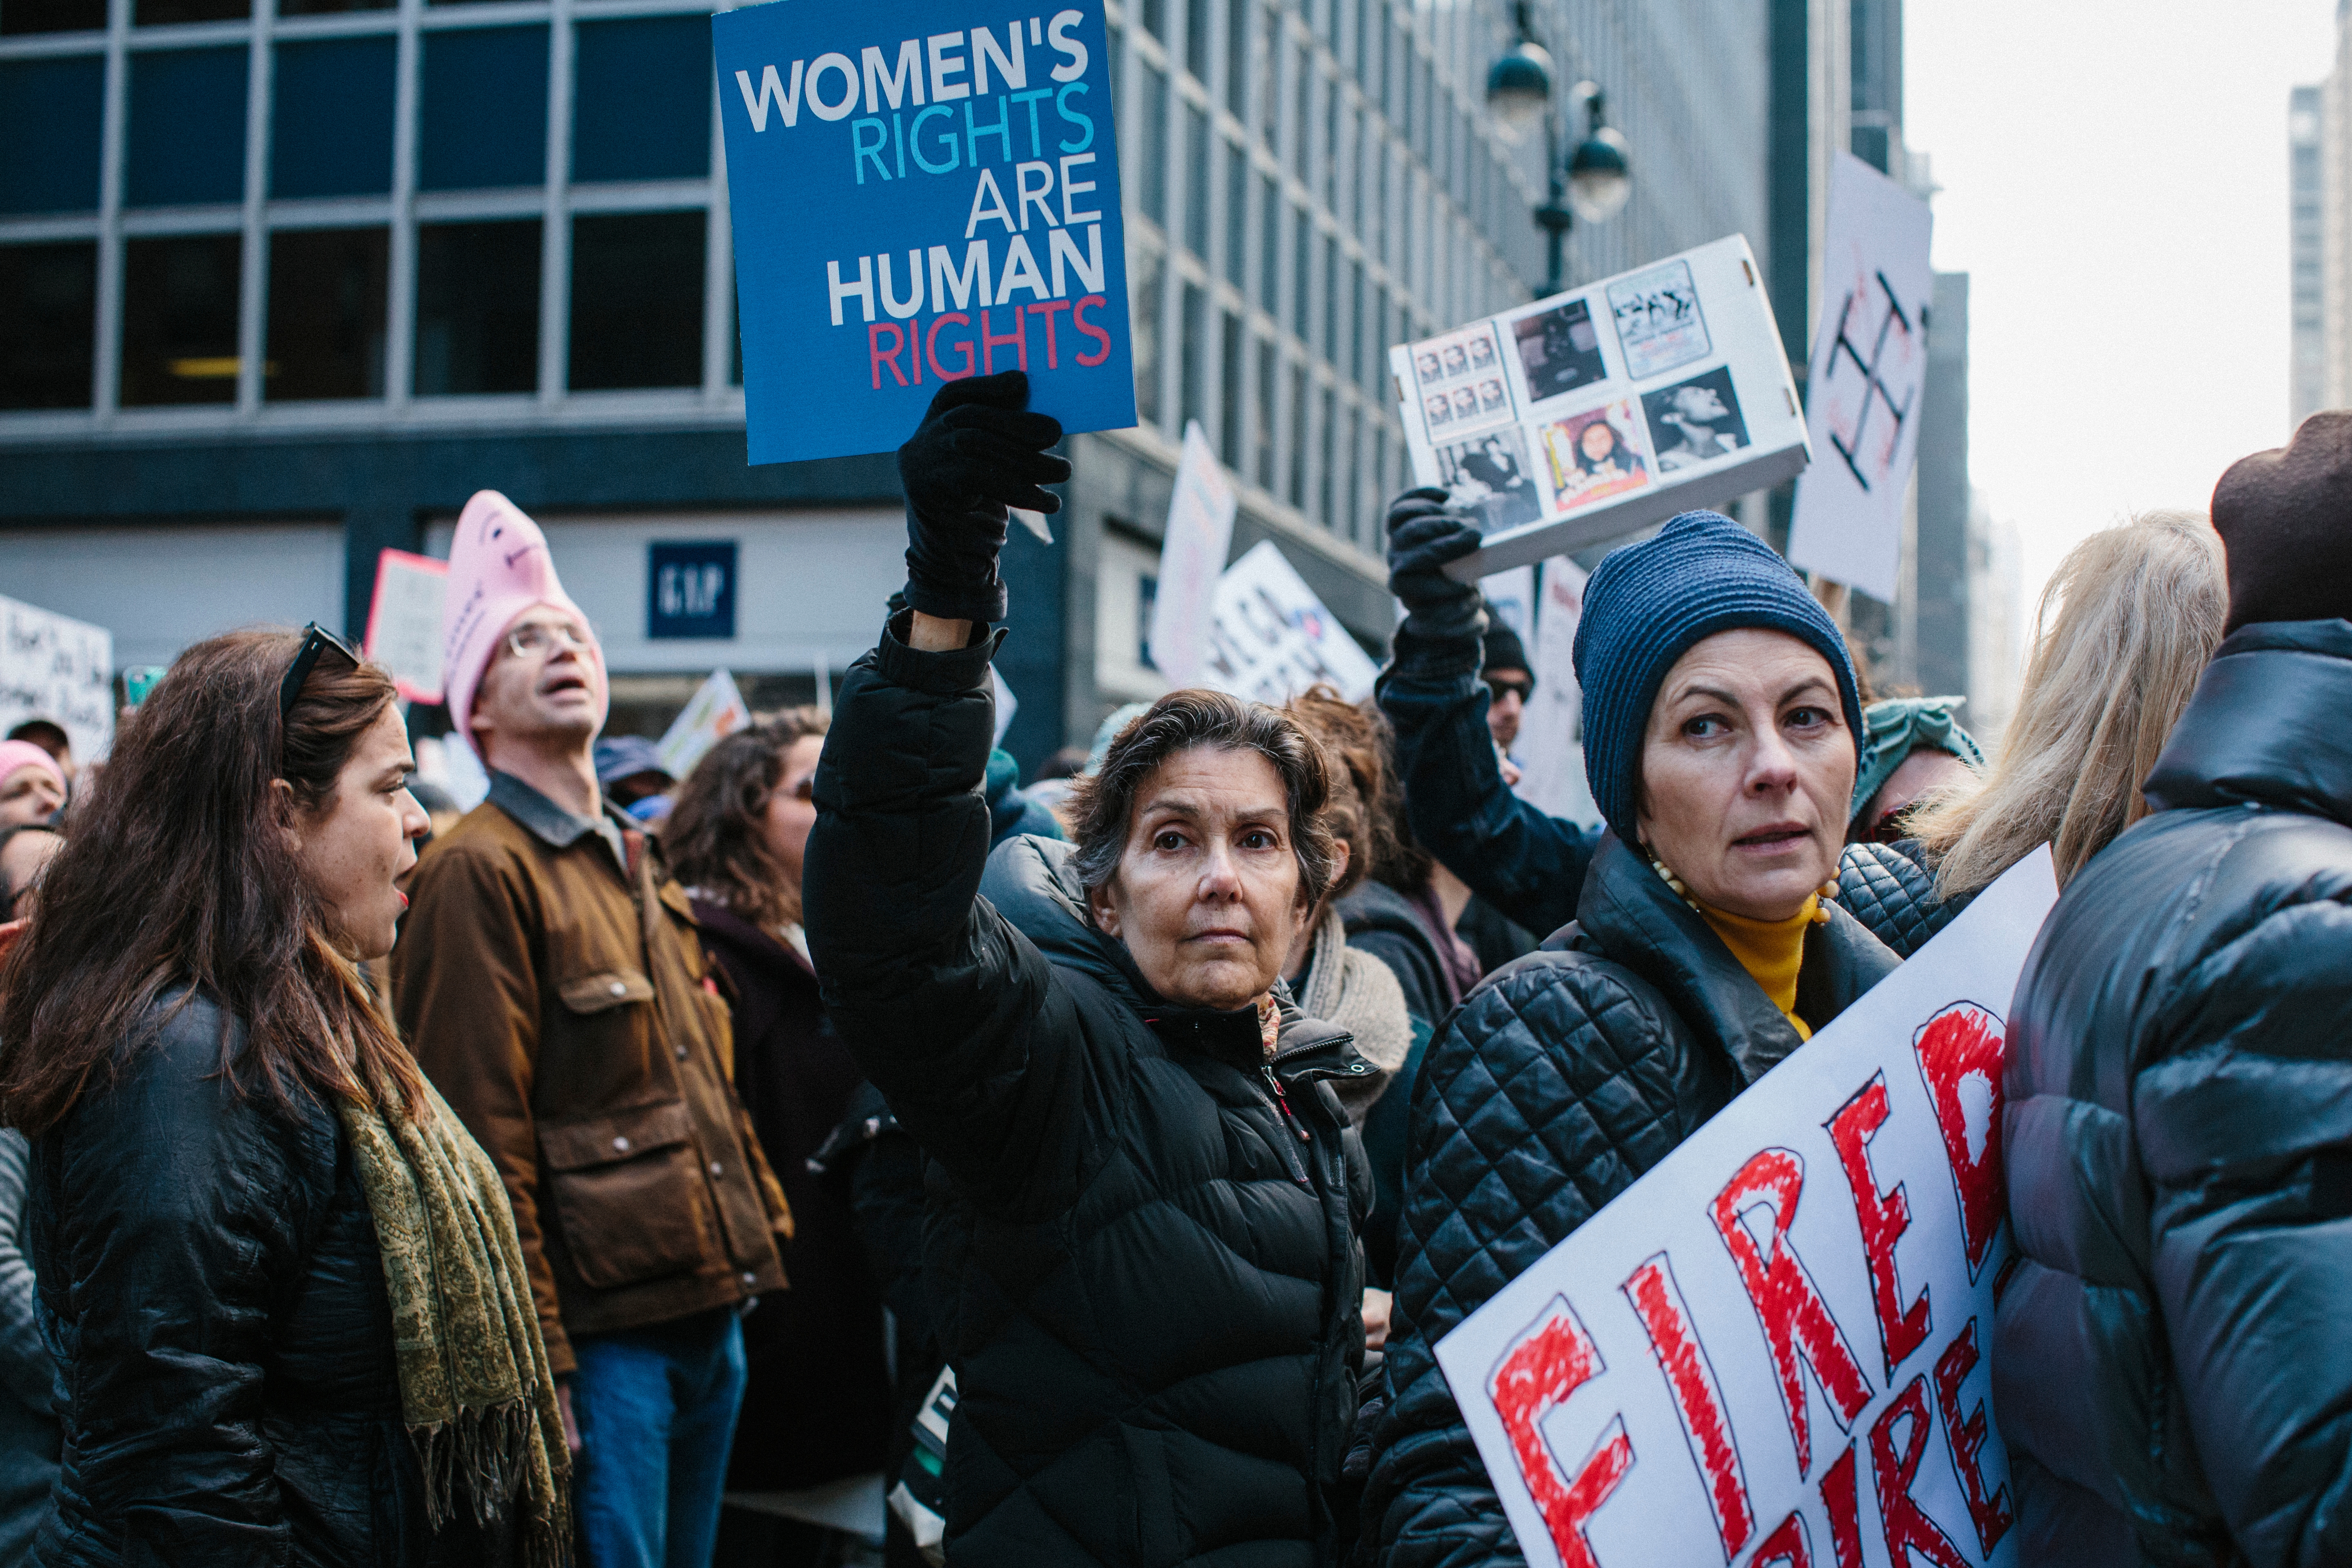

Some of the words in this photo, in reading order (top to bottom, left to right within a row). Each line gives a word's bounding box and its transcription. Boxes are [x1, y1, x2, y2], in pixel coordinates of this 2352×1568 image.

[735, 9, 1089, 133] WOMEN'S
[851, 81, 1095, 185] RIGHTS
[964, 152, 1102, 239] ARE
[826, 223, 1106, 326] HUMAN
[868, 294, 1111, 390] RIGHTS
